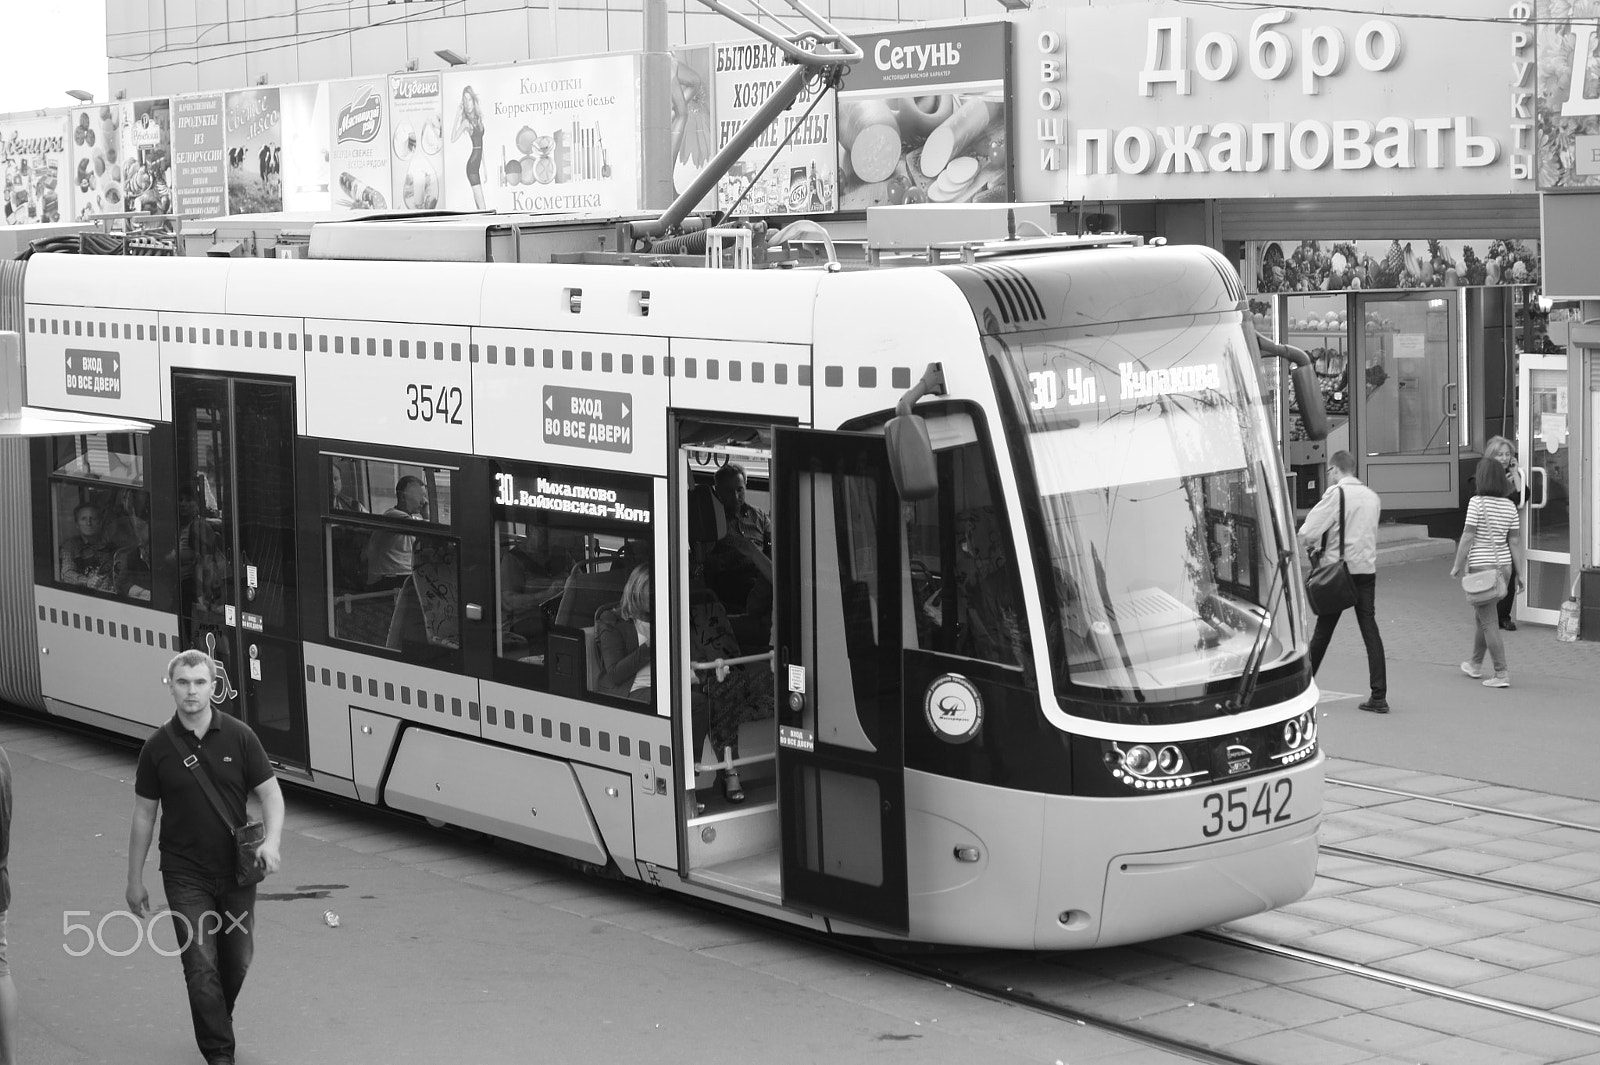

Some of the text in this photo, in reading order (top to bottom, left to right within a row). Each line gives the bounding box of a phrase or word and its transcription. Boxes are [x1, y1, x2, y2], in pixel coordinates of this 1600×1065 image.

[716, 44, 777, 72] БЫТОВАЯ
[874, 38, 960, 71] Сетунь
[1138, 9, 1402, 97] Добро
[519, 77, 582, 94] Колготки
[1509, 2, 1533, 180] ФРУКТЫ
[494, 99, 585, 117] Корректирующее
[1037, 29, 1063, 171] ОВОЩИ
[178, 115, 218, 129] ПРОДУКТЫ
[785, 114, 830, 152] ЦЕНЫ
[194, 133, 204, 145] ИЗ
[1076, 114, 1500, 177] пожаловать
[176, 150, 222, 164] БЕЛОРУССИИ
[512, 190, 602, 211] Косметика
[82, 355, 103, 375] ВХОД
[67, 375, 120, 393] ВО ВСЕ ДВЕРИ
[1029, 362, 1220, 410] 30 Ул. Кулакова
[406, 383, 463, 425] 3542
[571, 396, 602, 419] ВХОД
[545, 418, 630, 445] ВО ВСЕ ДВЕРИ
[536, 477, 617, 503] Михалково
[1202, 777, 1293, 838] 3542
